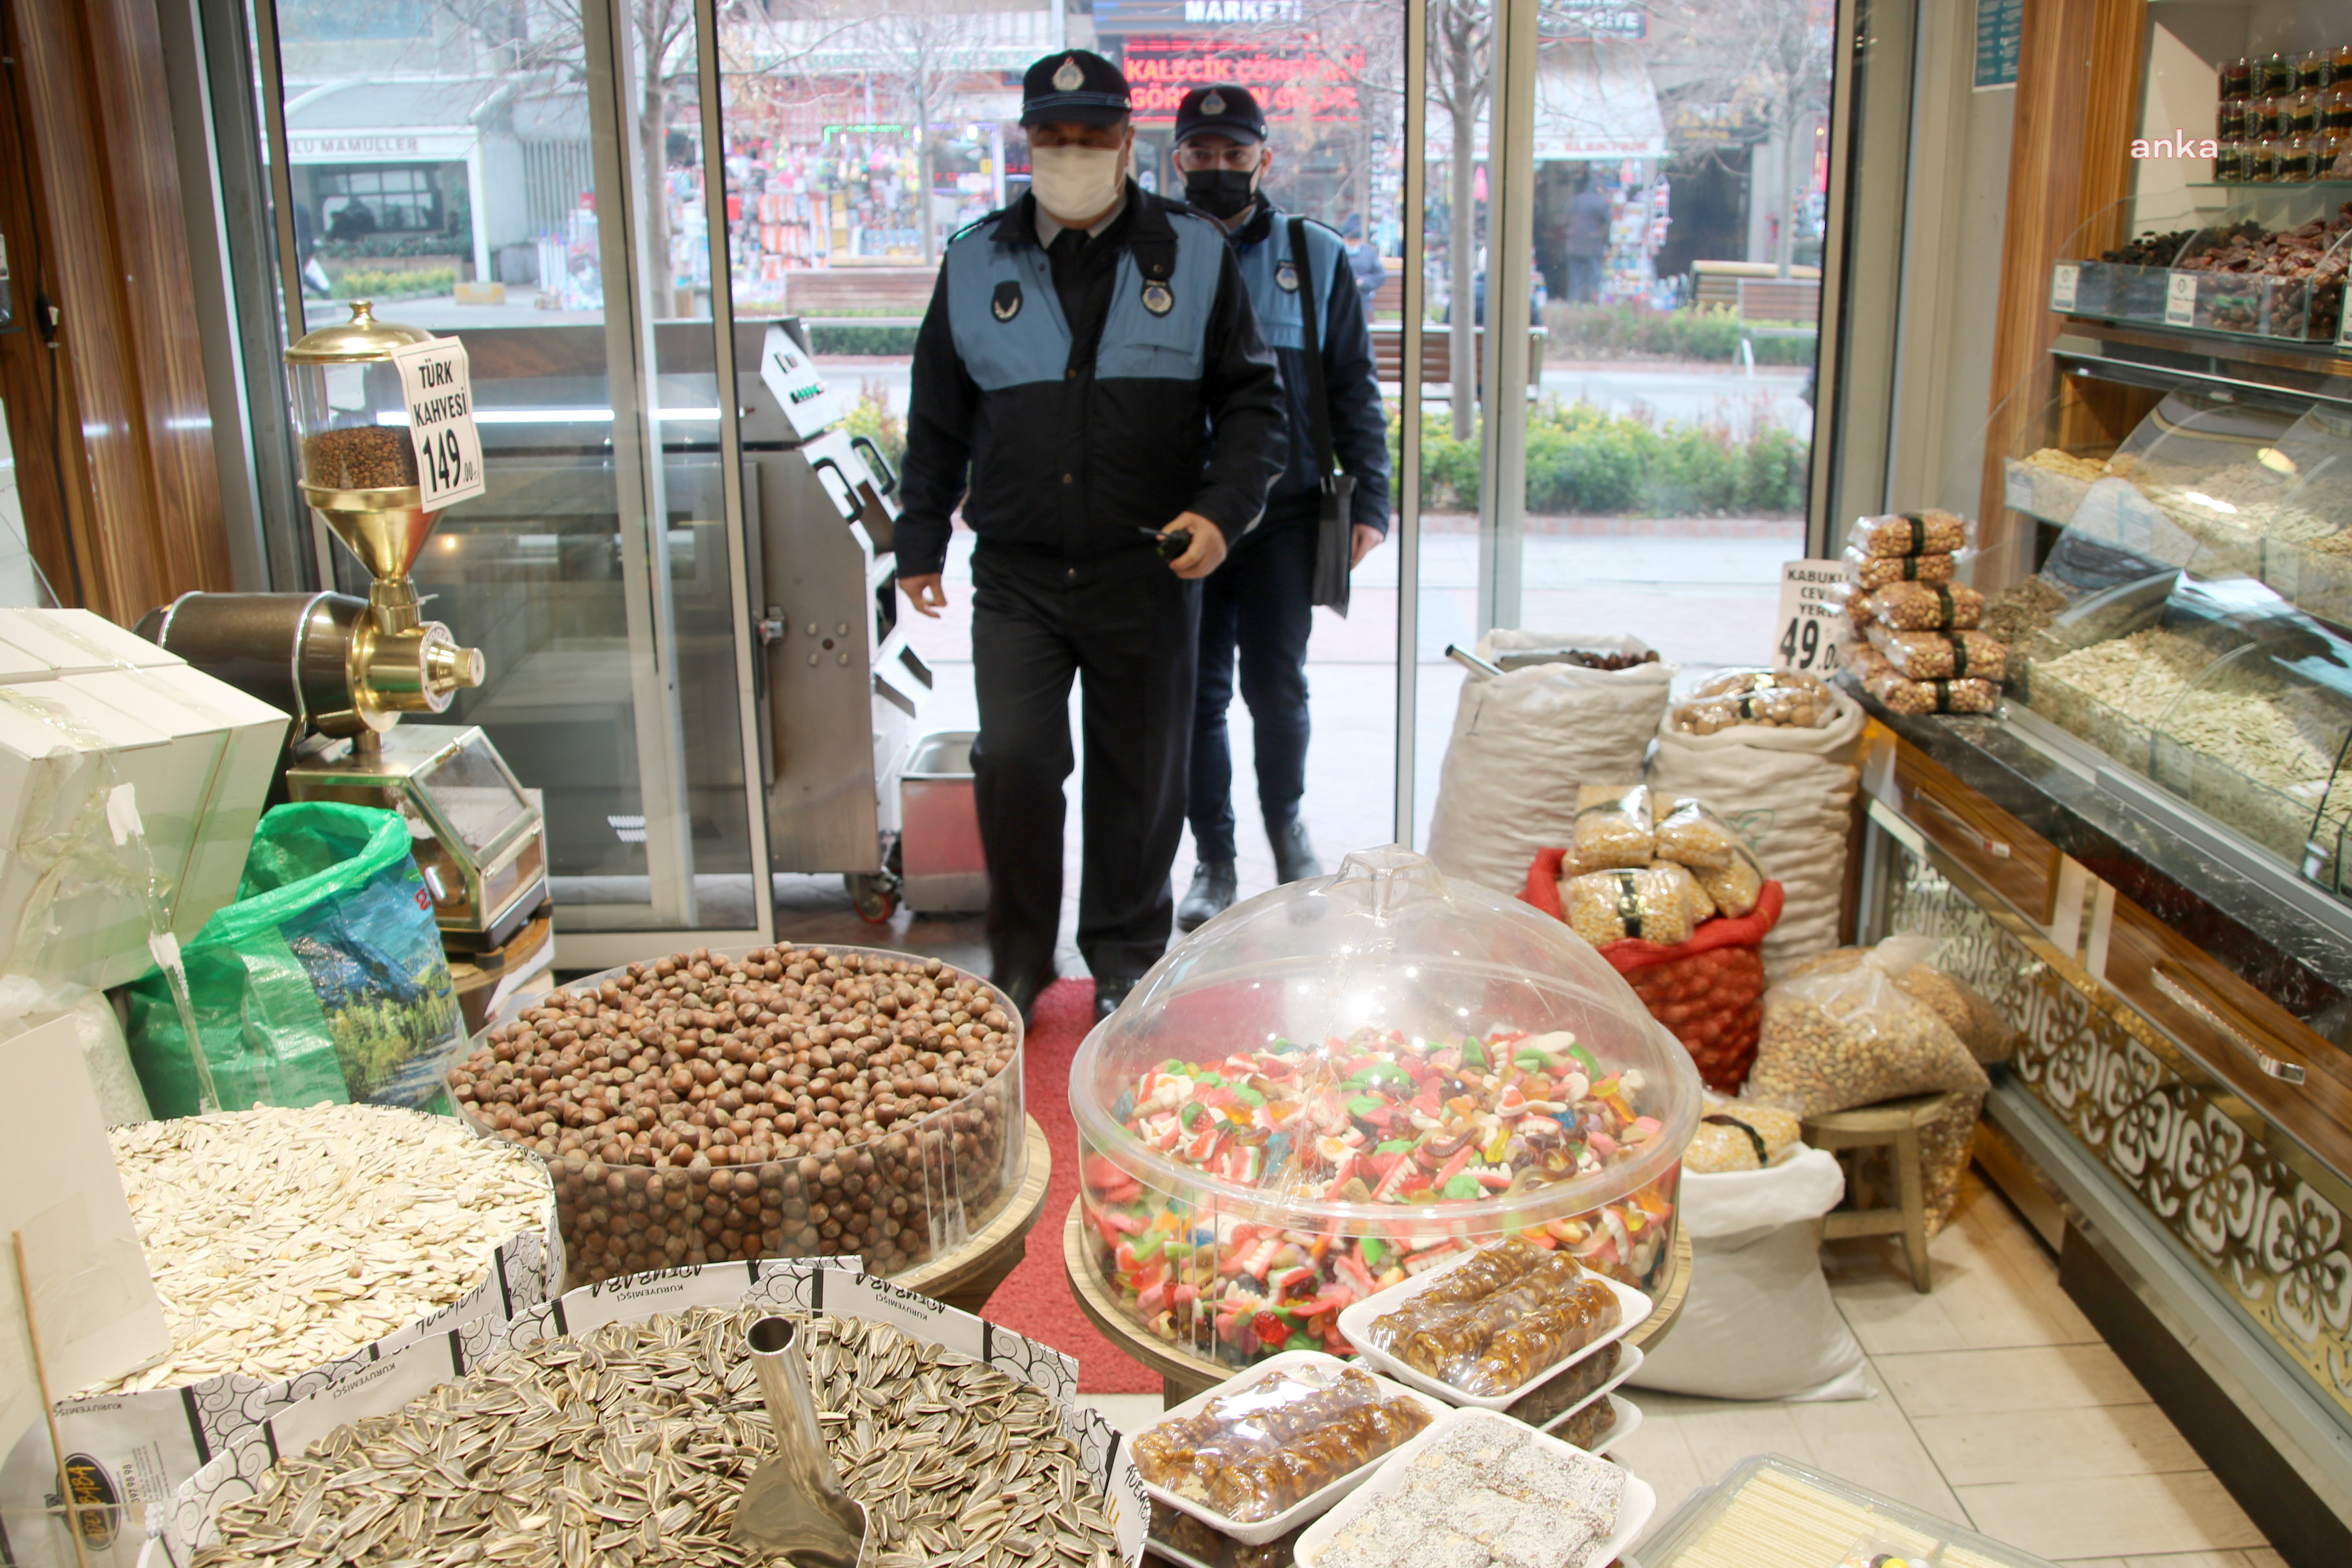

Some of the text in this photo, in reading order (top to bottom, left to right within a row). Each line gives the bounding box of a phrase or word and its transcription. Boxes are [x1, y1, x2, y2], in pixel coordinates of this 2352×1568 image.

[1126, 53, 1233, 82] KALECİK
[418, 358, 453, 389] TÜRK
[413, 386, 468, 427] KAHVESİ
[617, 1283, 684, 1302] KURUYEMİŞÇİ
[875, 1293, 928, 1321] KURUYEMİŞÇİ
[333, 1362, 396, 1400] KURUYEMİŞÇİ
